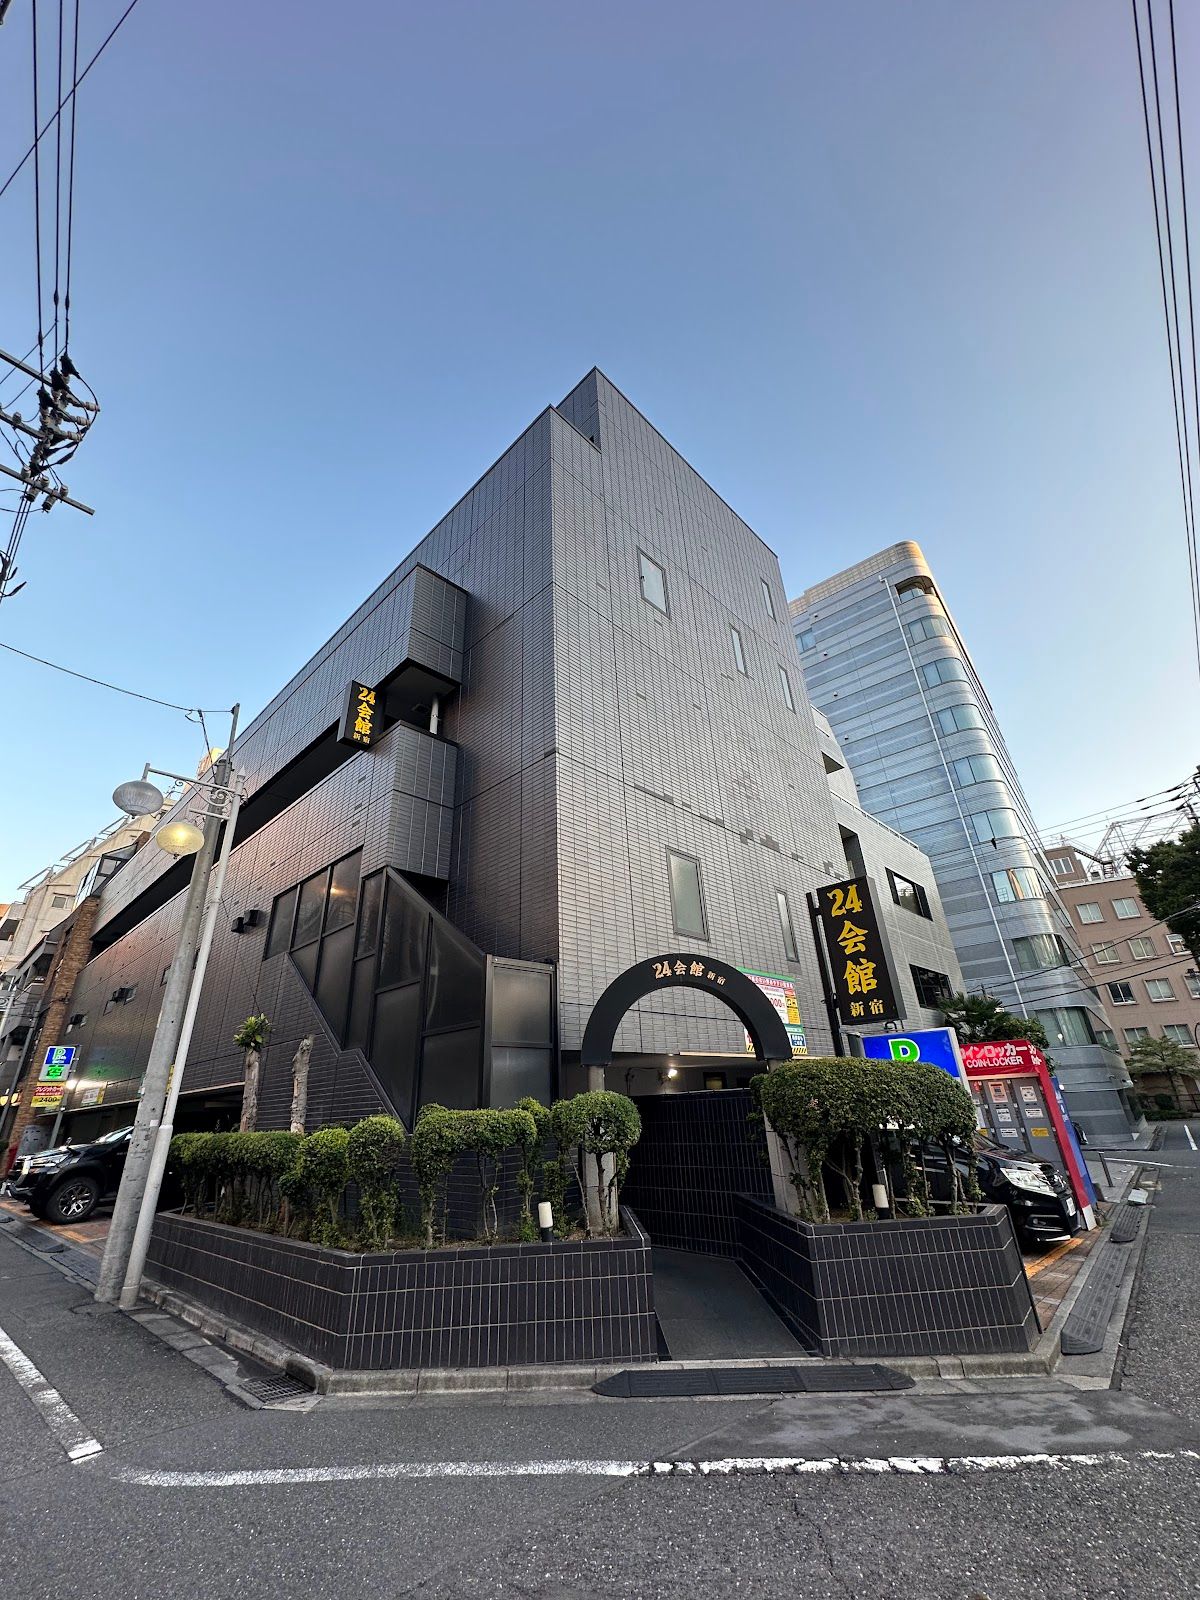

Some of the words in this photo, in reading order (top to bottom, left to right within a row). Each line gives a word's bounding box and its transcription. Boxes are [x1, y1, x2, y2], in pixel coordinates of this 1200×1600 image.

[355, 687, 376, 734] 24会館
[827, 884, 878, 994] 24会館
[652, 960, 705, 980] 24会館
[706, 970, 727, 986] 新宿
[850, 999, 884, 1017] 新宿
